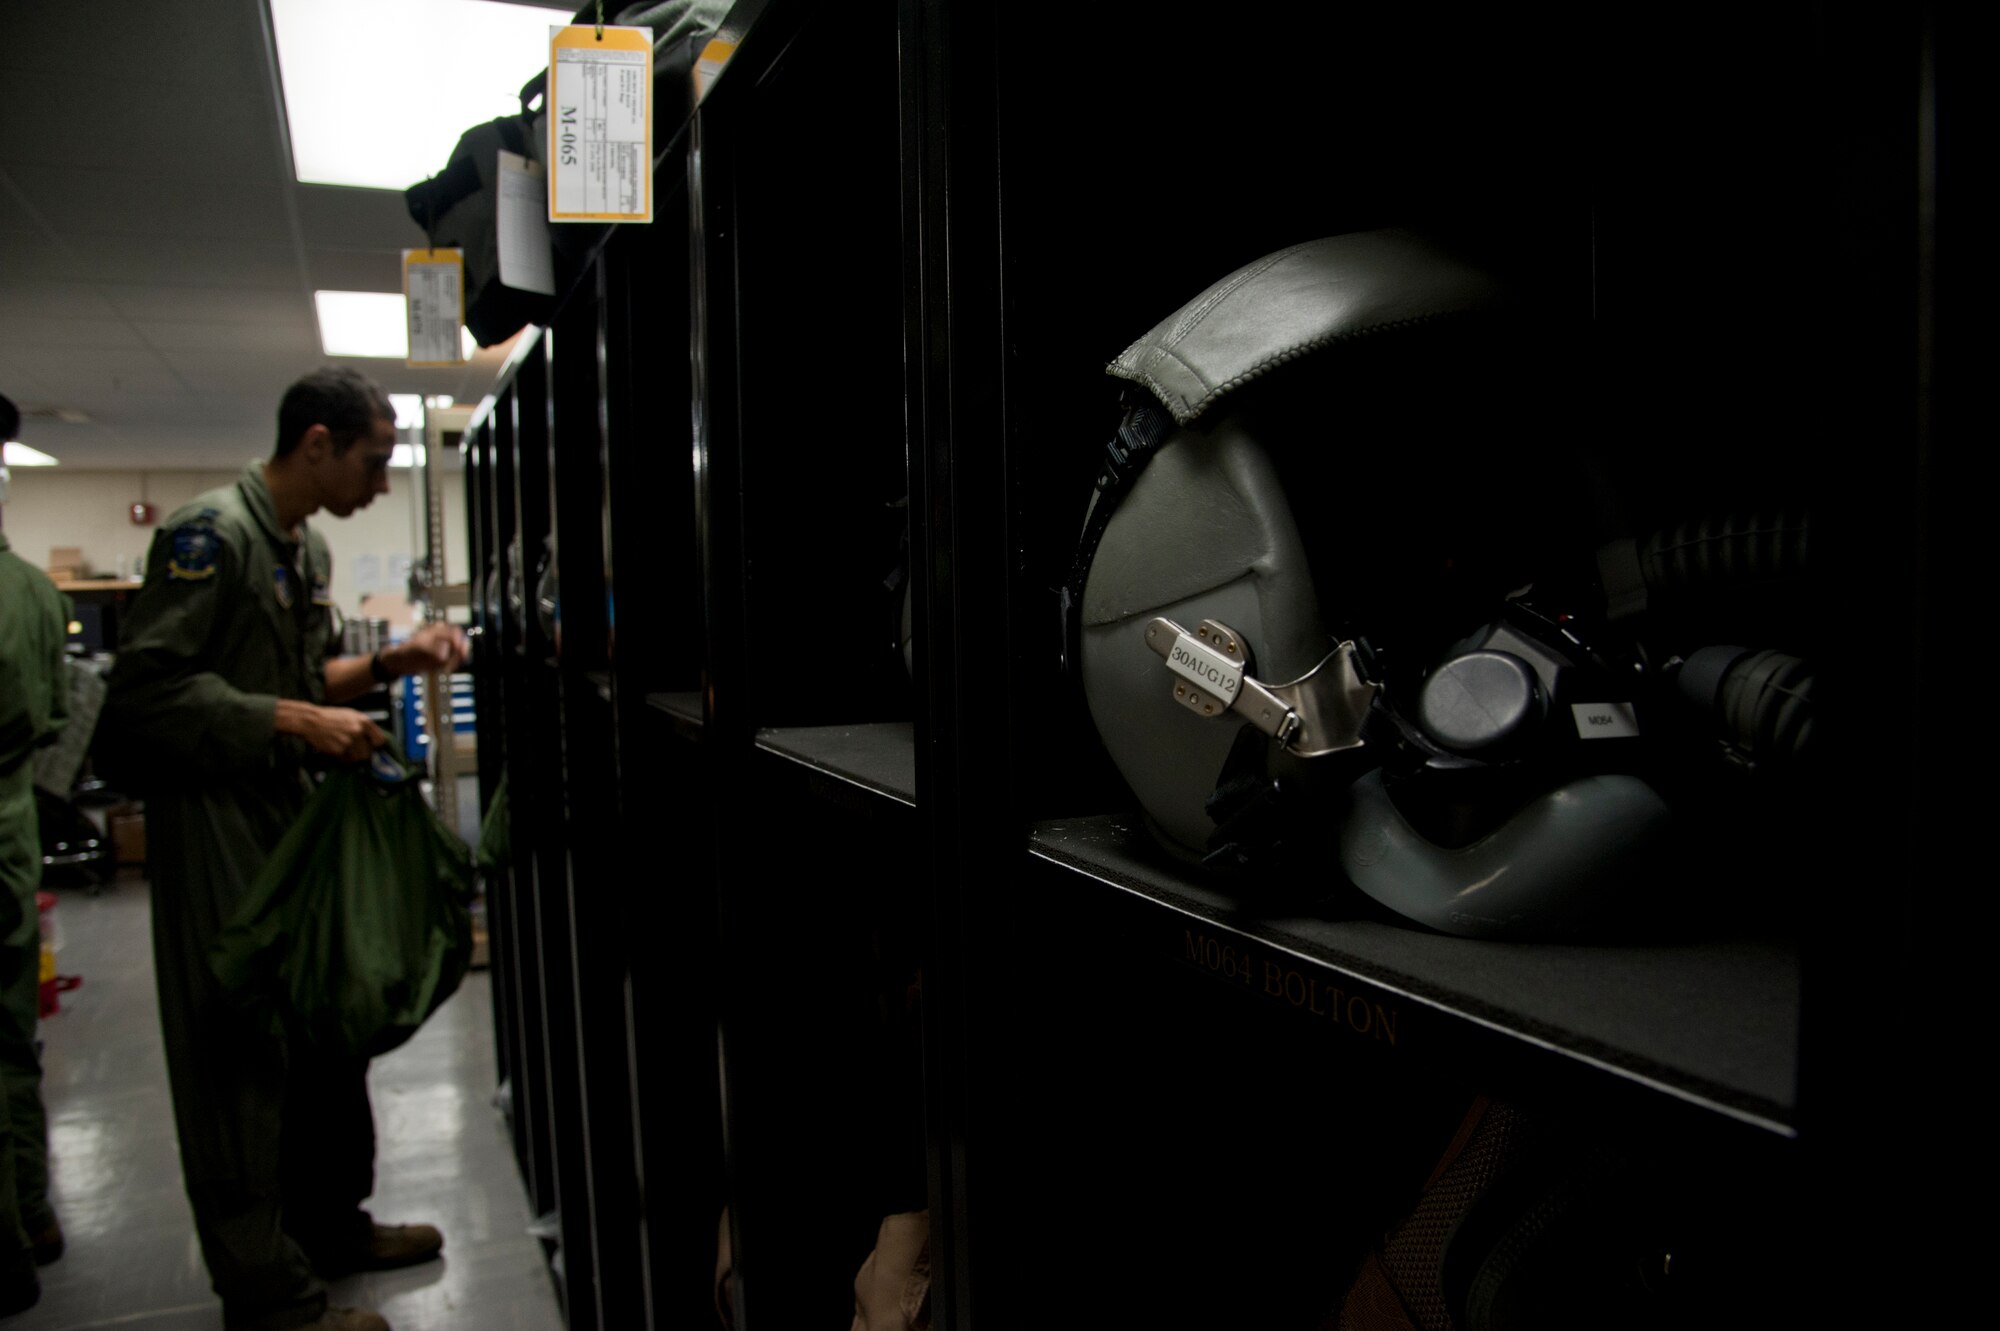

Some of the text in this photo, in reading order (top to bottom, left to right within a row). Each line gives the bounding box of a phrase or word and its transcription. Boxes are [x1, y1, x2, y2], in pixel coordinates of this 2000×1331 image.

[560, 105, 577, 166] M-065
[1171, 646, 1236, 693] 30AUG12
[1185, 929, 1398, 1047] M064 BOLTON
